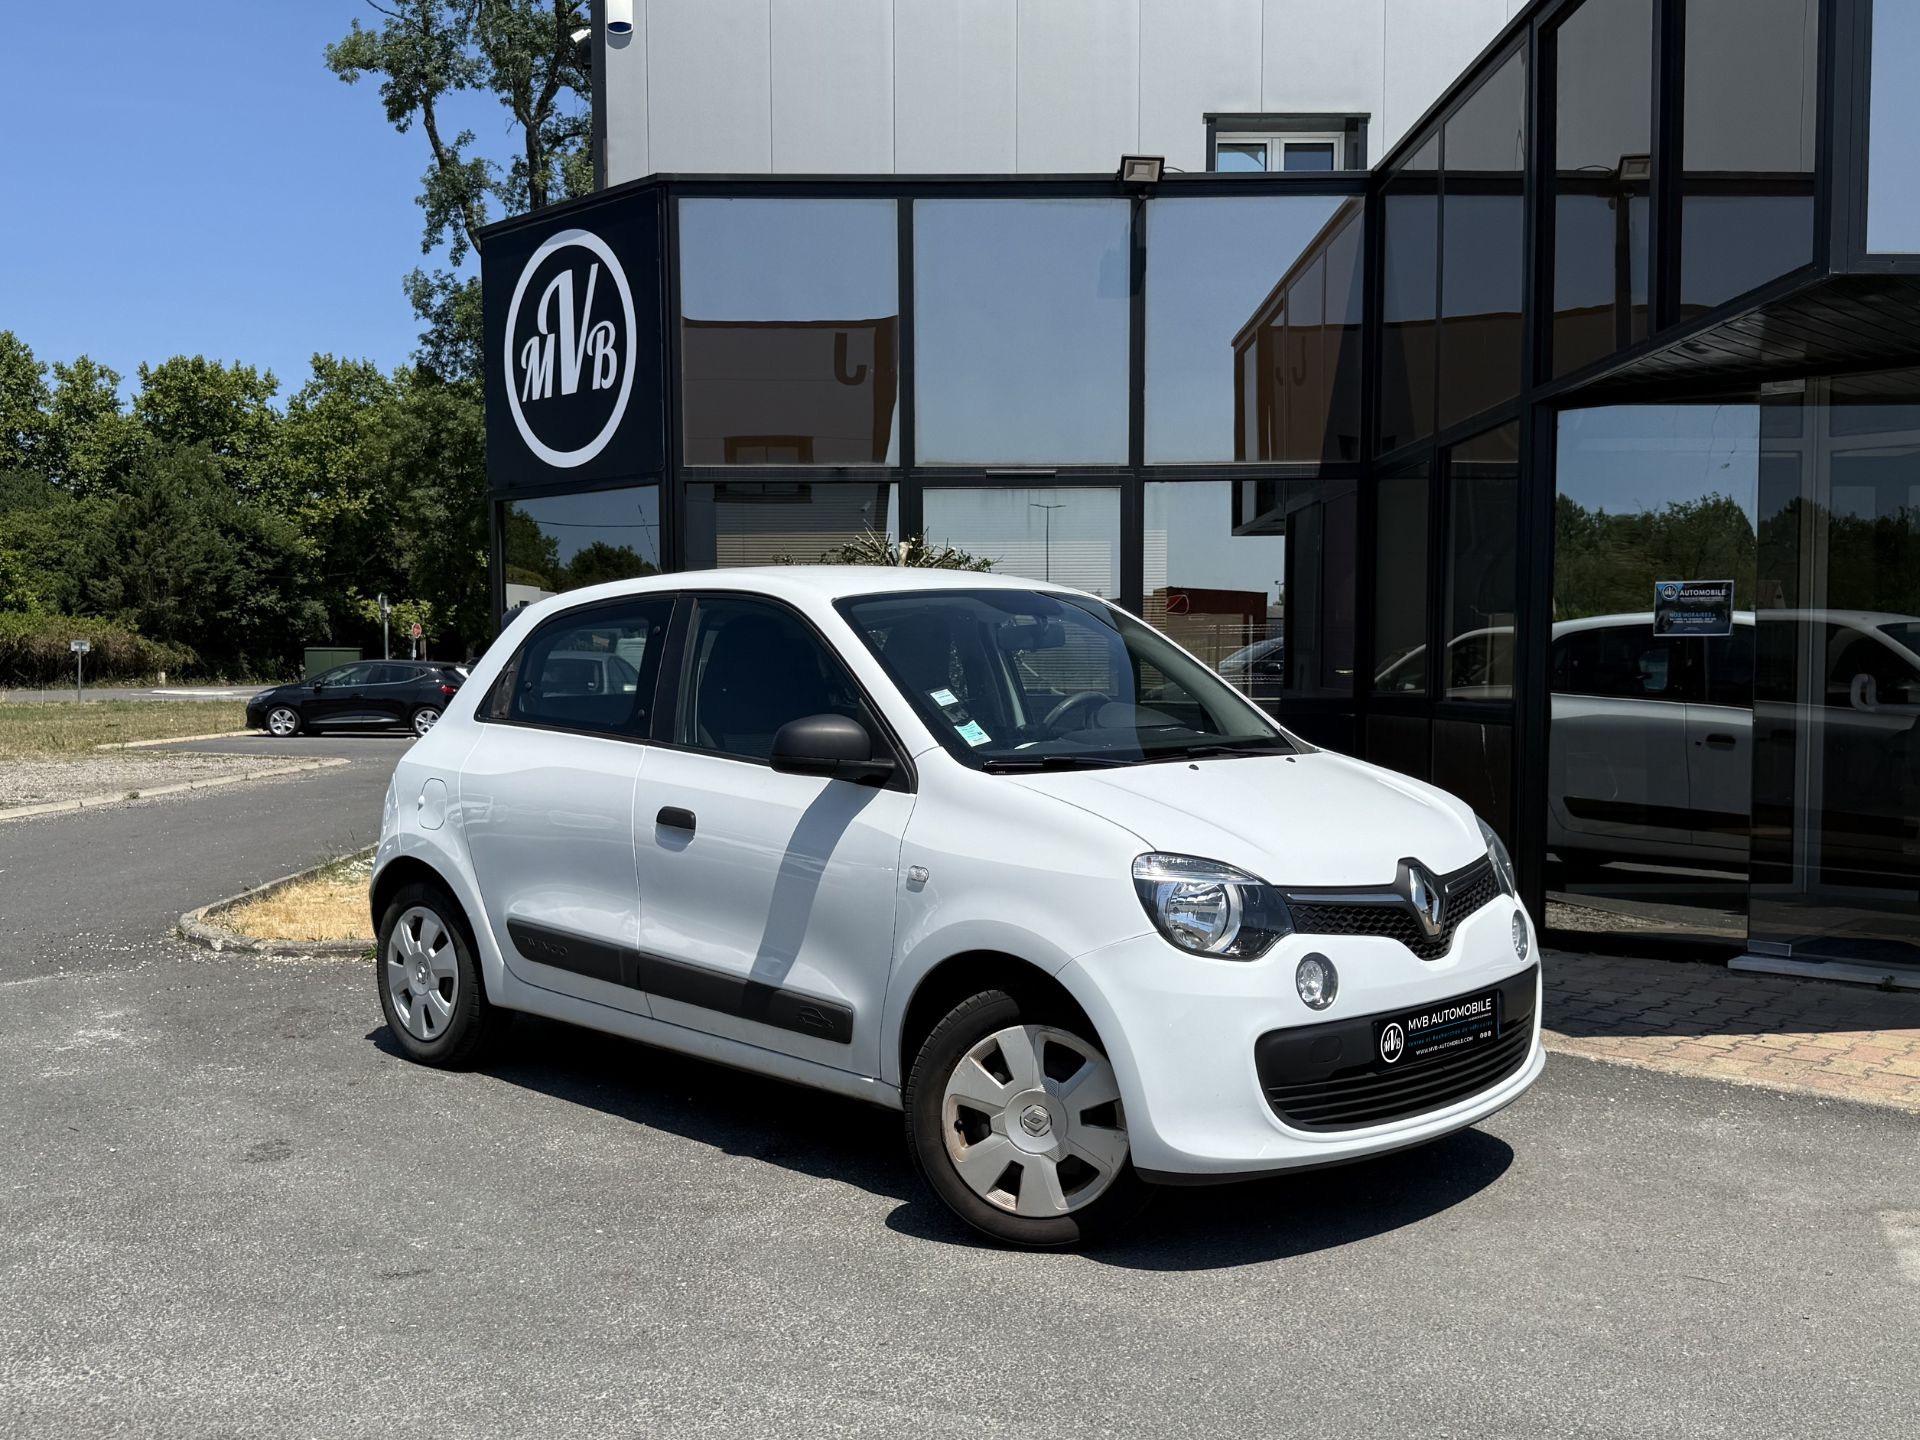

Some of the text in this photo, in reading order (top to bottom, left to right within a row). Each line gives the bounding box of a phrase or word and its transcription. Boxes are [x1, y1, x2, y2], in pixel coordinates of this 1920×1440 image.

[521, 263, 618, 402] MVB
[1679, 588, 1726, 596] AUTOMOBILE
[1408, 1015, 1429, 1032] MVB
[1430, 998, 1492, 1025] AUTOMOBILE
